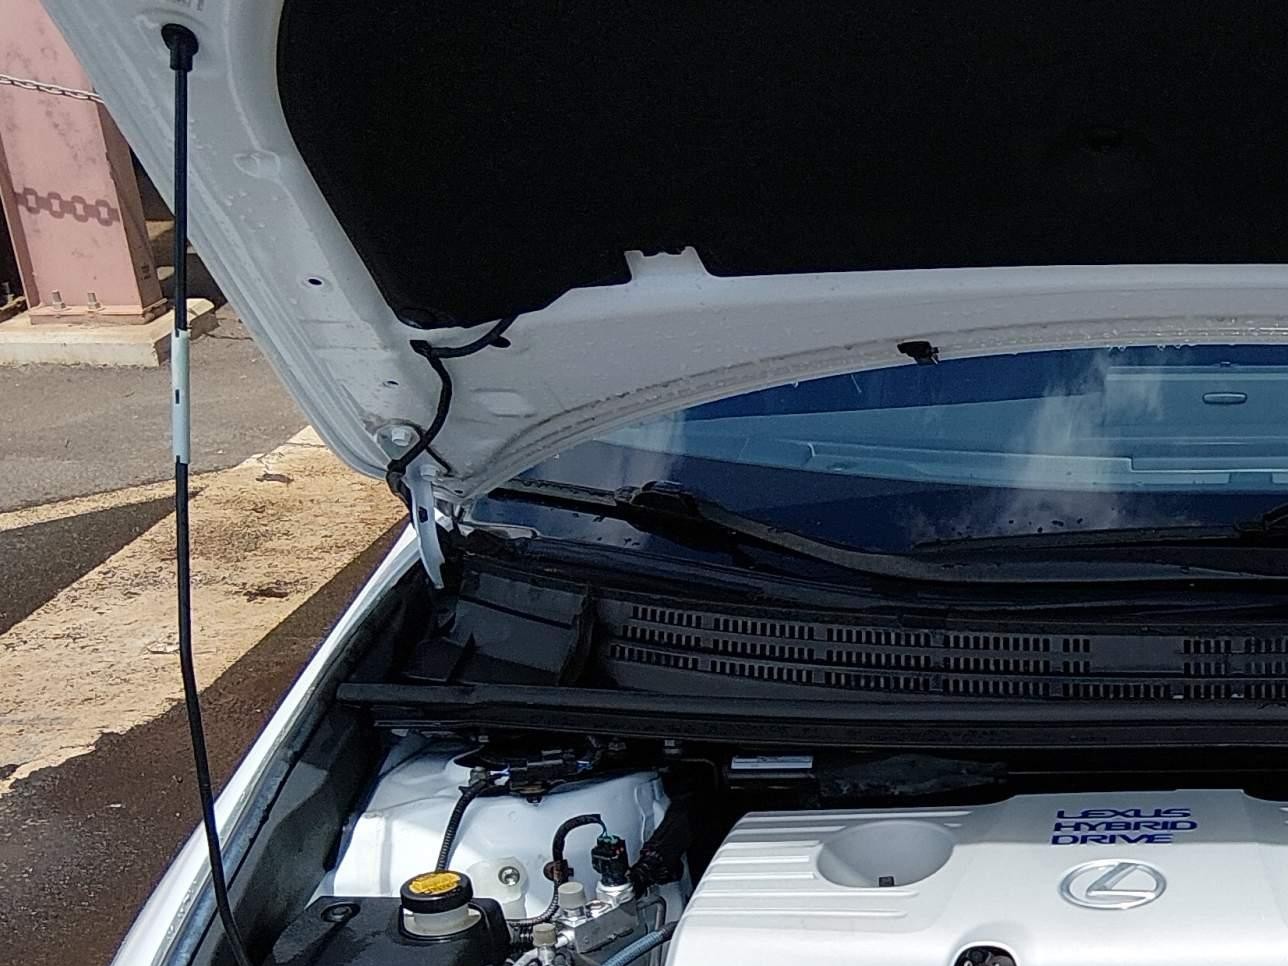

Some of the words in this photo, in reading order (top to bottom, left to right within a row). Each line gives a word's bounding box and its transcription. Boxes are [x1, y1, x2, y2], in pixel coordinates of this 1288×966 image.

[1057, 808, 1192, 818] LEXUS
[1054, 821, 1197, 831] HYBRID
[1051, 834, 1174, 845] DRIVE
